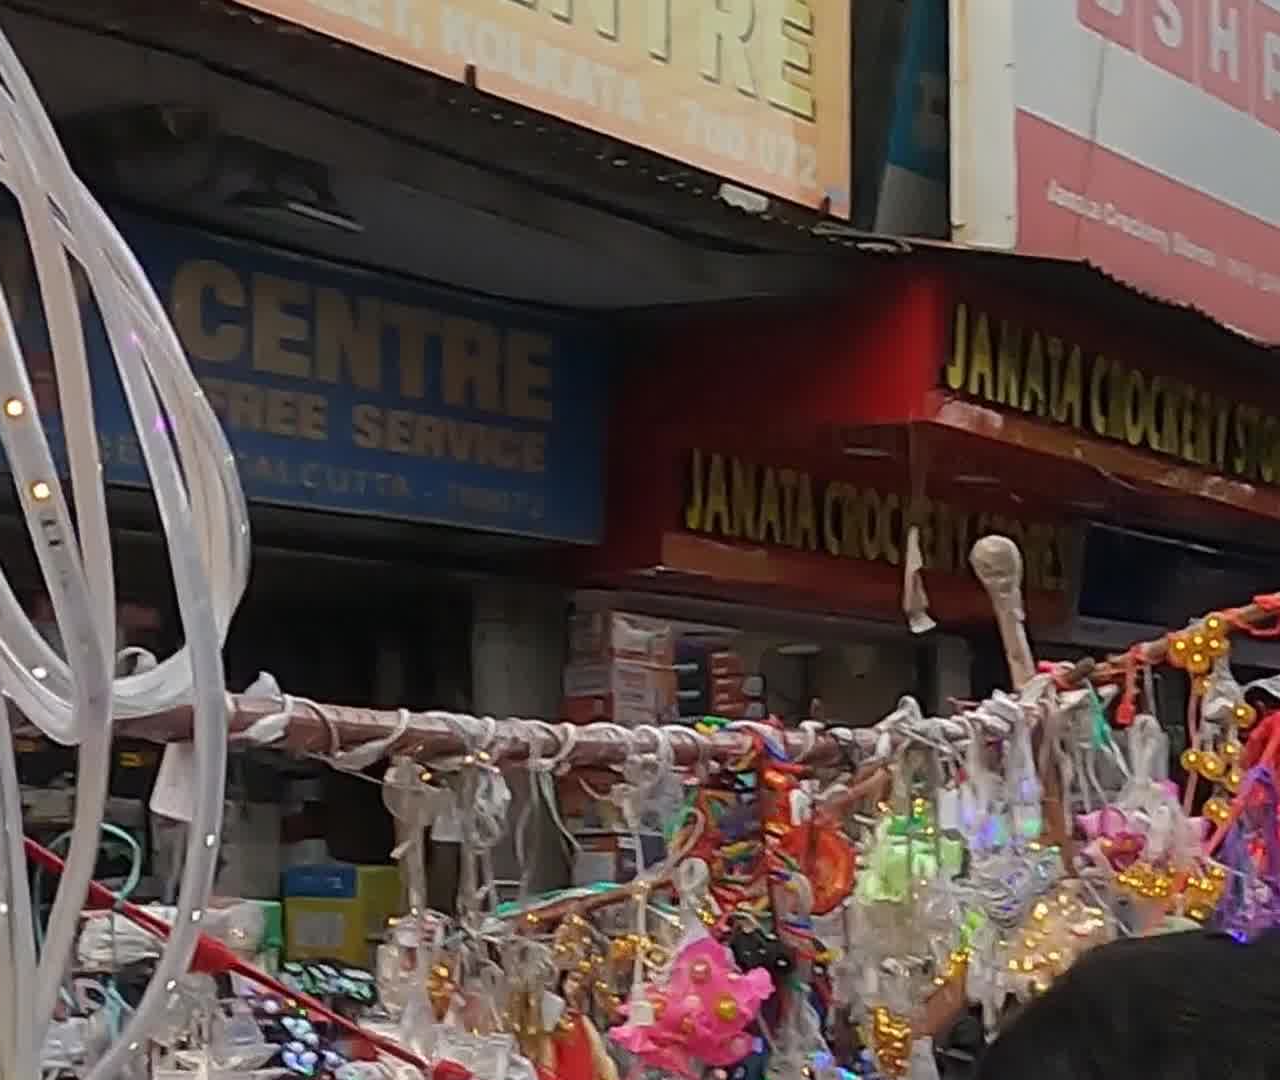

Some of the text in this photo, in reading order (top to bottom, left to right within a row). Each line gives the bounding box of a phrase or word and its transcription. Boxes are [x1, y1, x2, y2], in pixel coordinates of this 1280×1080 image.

[170, 258, 553, 421] CENTRE
[947, 302, 1083, 430] JANATA
[1089, 353, 1228, 471] CROCKERY
[351, 400, 547, 474] SERVICE
[686, 446, 817, 552] JANATA
